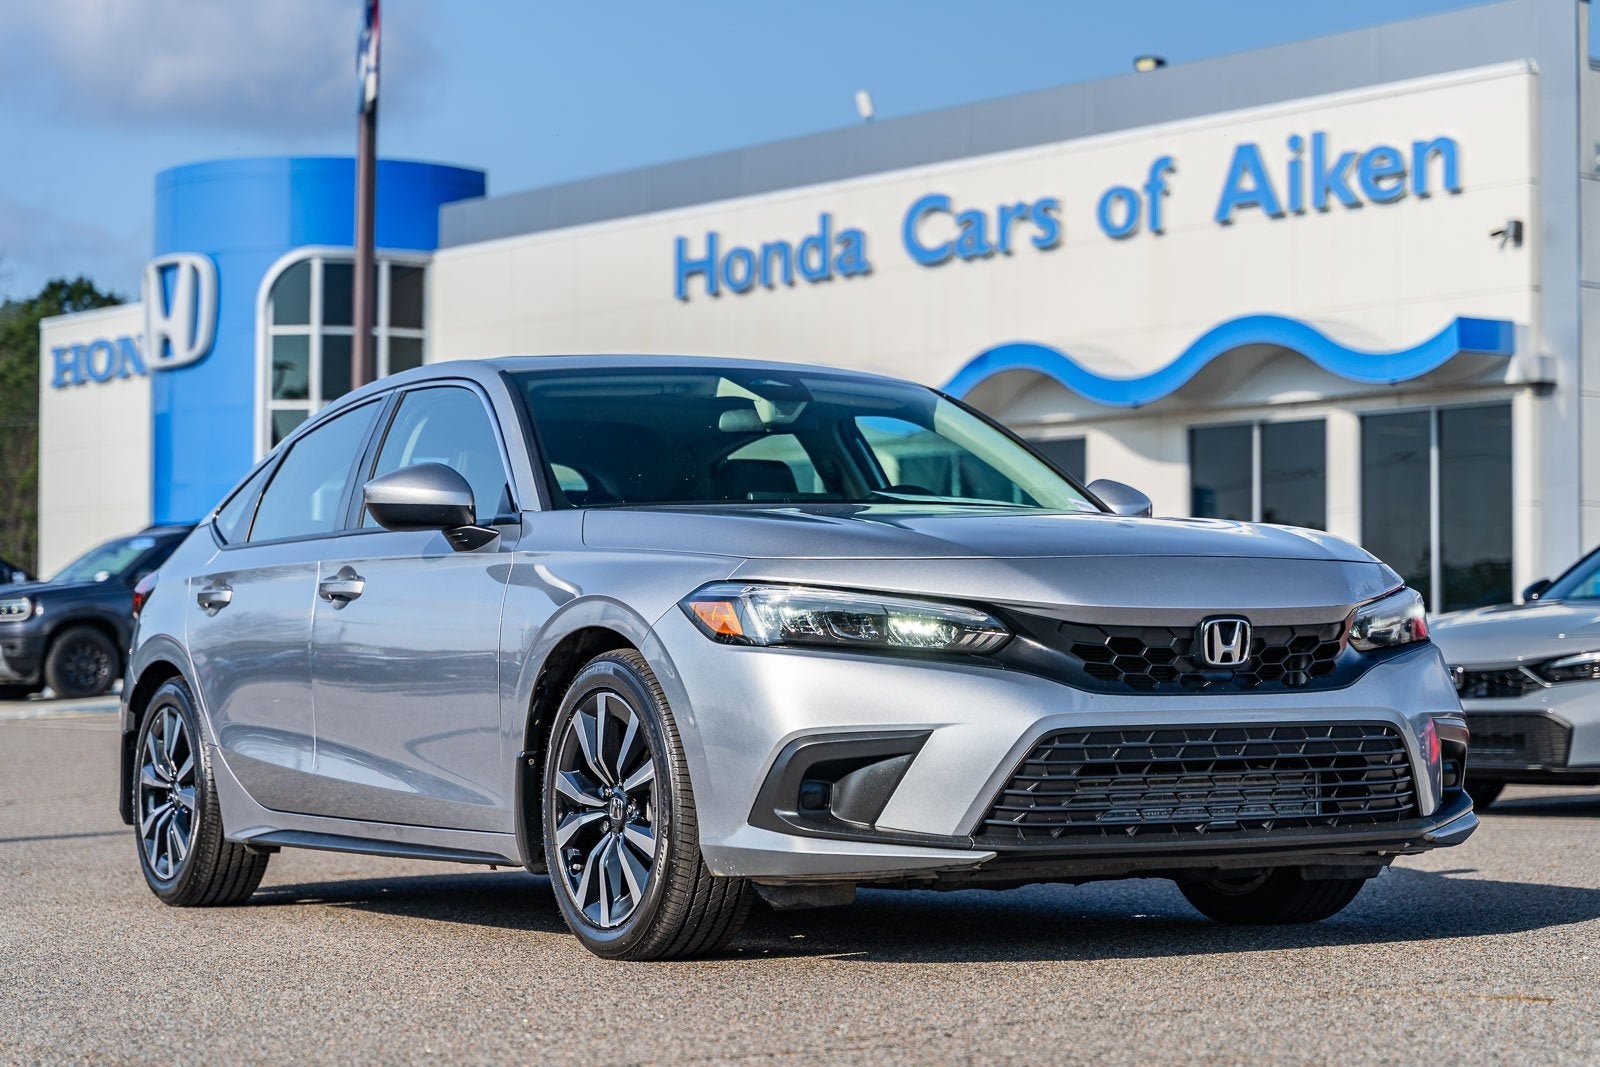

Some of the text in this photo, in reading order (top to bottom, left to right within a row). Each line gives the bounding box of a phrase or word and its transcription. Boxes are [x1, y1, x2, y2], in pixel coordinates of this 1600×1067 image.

[674, 131, 1462, 301] Honda Cars of Aiken
